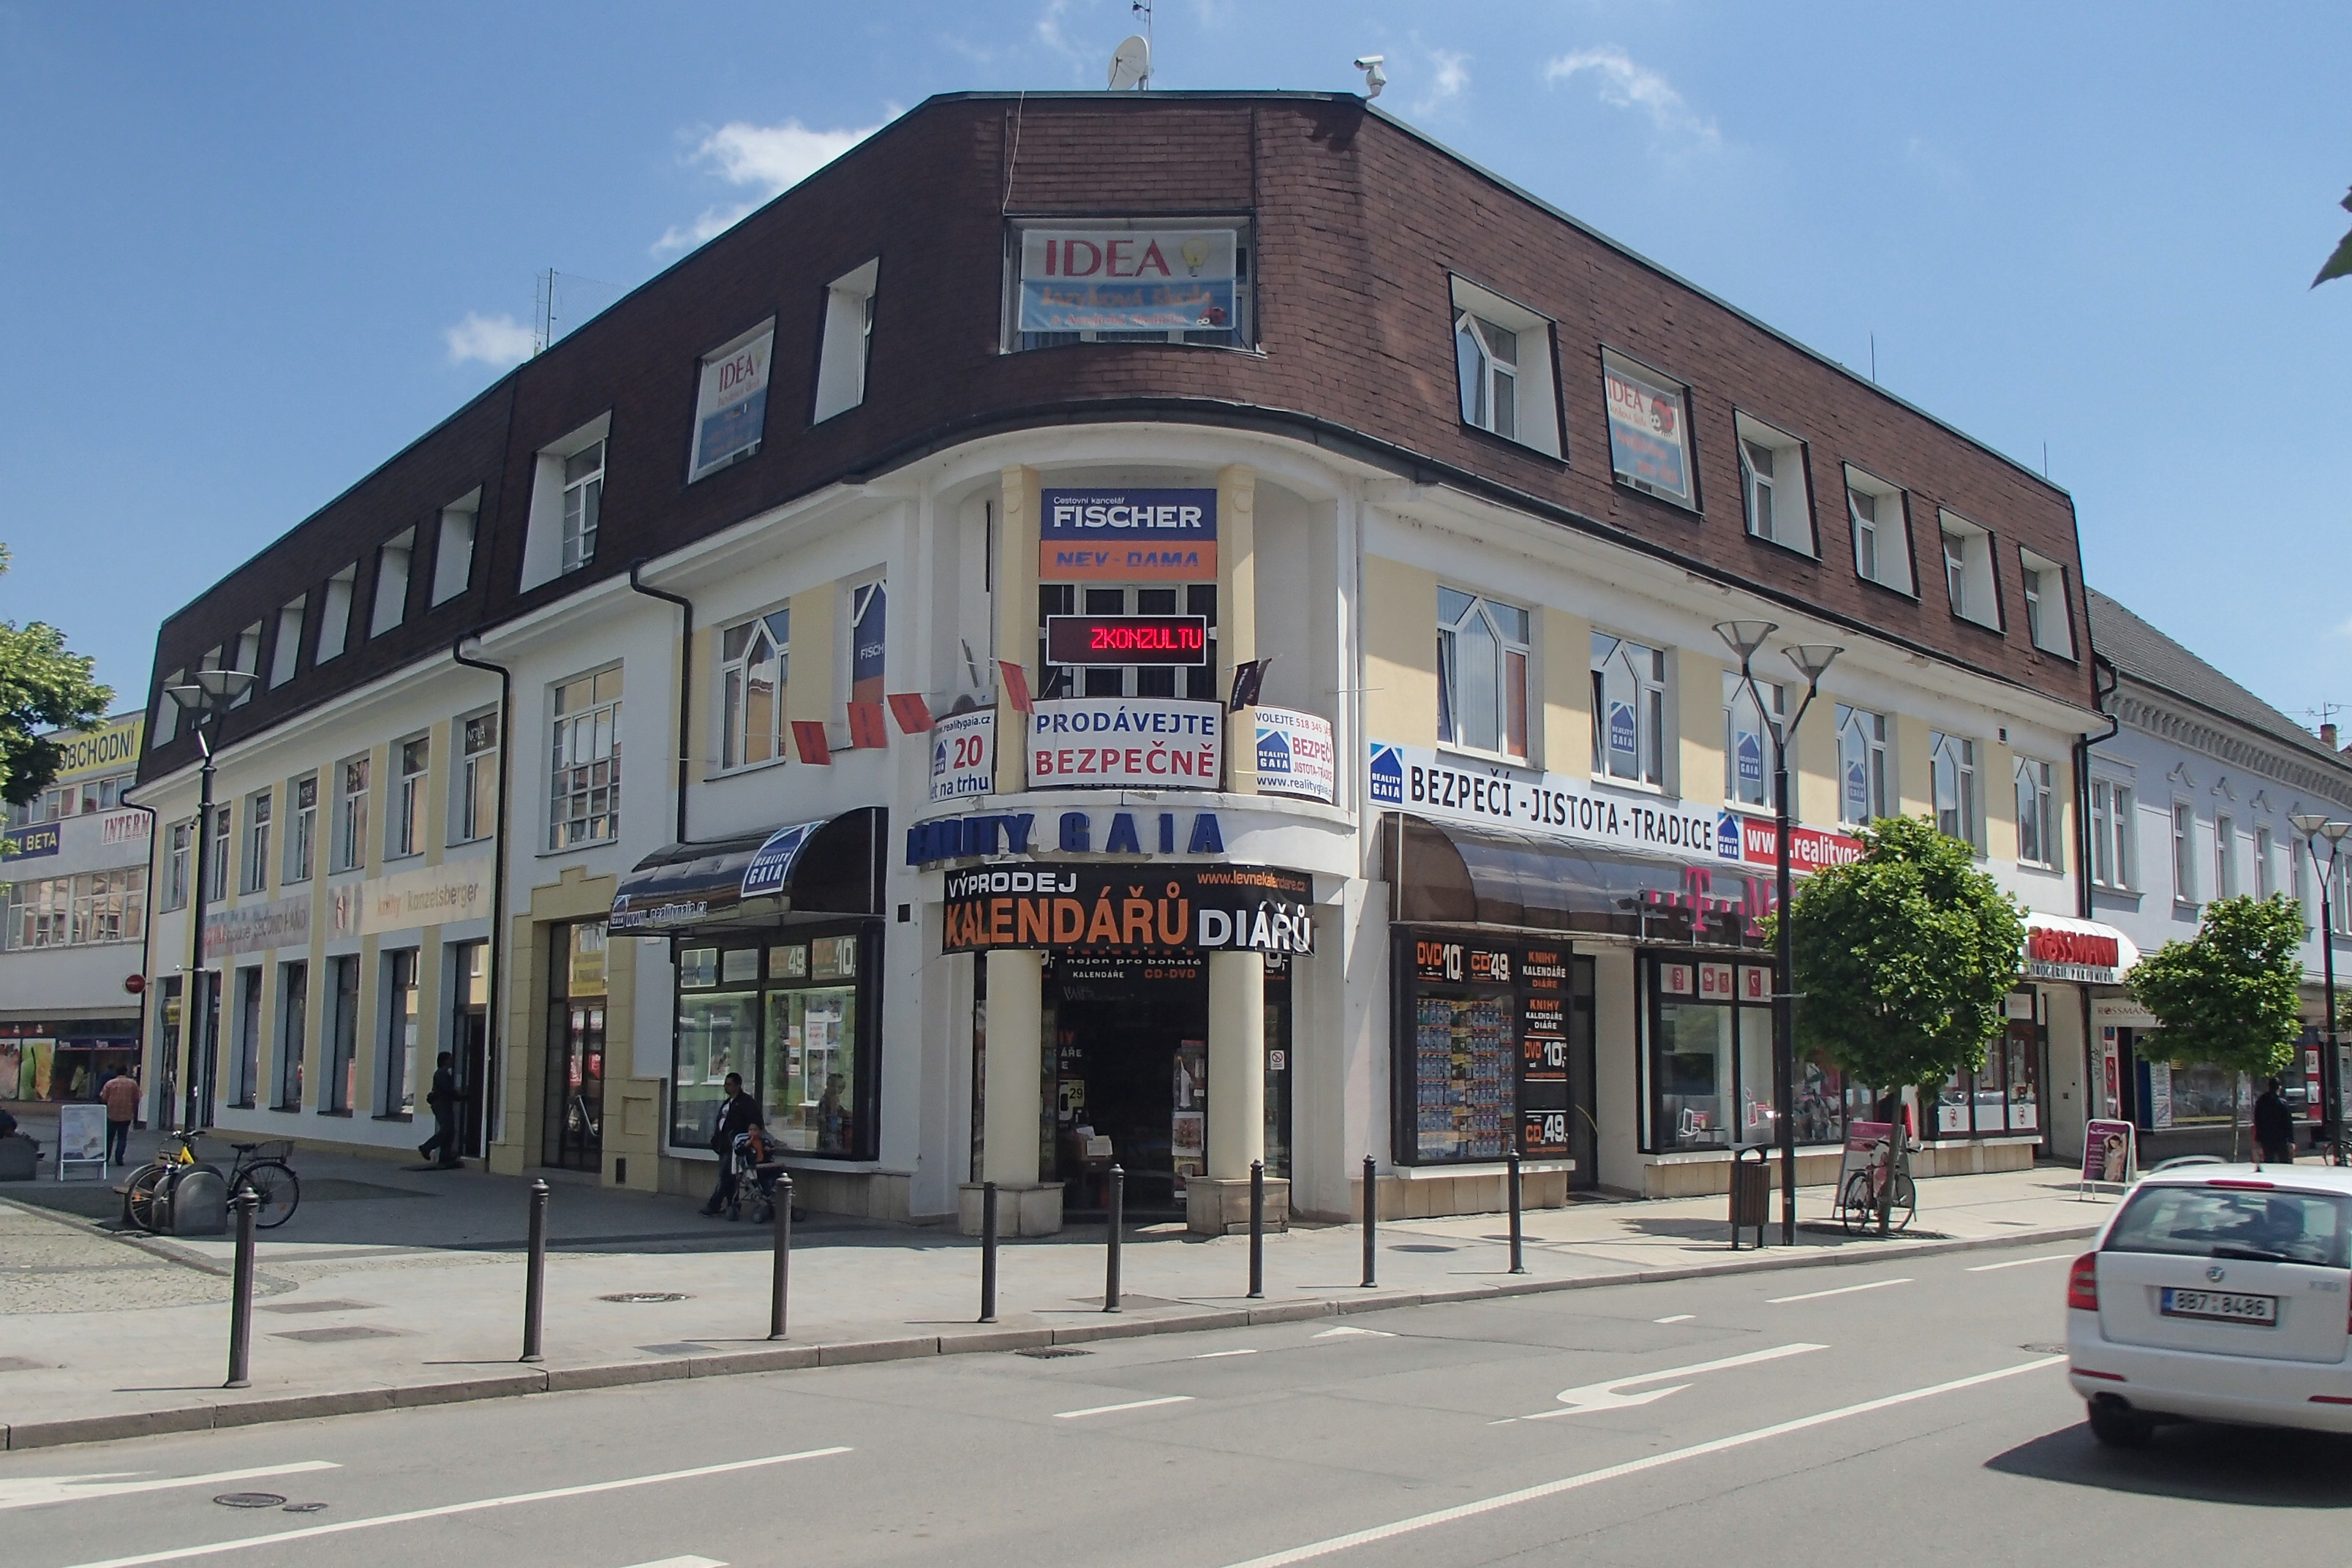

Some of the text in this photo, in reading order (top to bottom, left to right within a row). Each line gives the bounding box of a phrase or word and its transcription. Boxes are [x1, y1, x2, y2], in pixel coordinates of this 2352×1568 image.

[1046, 238, 1172, 277] IDEA
[719, 351, 755, 393] IDEA
[1606, 374, 1644, 414] IDEA
[1053, 496, 1125, 505] Cestovní kancelář
[1052, 506, 1202, 528] FISCHER
[1055, 551, 1110, 568] NEV
[1126, 551, 1199, 568] DAMA
[1090, 627, 1202, 649] ZKONZULTU
[1036, 706, 1215, 736] PRODÁVEJTE
[1255, 712, 1294, 726] VOLEJTE
[1296, 718, 1309, 729] 518
[1612, 734, 1633, 747] GAIA
[954, 735, 984, 769] 20
[1036, 741, 1215, 777] BEZPEČNĚ
[1259, 750, 1289, 759] REALITY
[1260, 758, 1289, 769] GAIA
[1741, 764, 1759, 776] GAIA
[941, 782, 954, 796] na
[957, 773, 989, 794] trhu
[1371, 773, 1401, 784] REALITY
[1373, 783, 1401, 799] GAIA
[26, 832, 58, 851] BETA
[1059, 813, 1225, 855] GAIA
[1719, 843, 1738, 856] GAIA
[748, 864, 783, 885] GAIA
[949, 870, 1306, 899] VÝPRODEJ www.levnekalendare.cz
[407, 883, 480, 912] kanzelsberger
[945, 881, 1311, 953] KALENDÁŘŮ DIÁŘŮ
[1417, 941, 1444, 966] DVD
[2028, 925, 2119, 968] ROSSMANN
[1066, 957, 1110, 967] nejen
[1116, 958, 1142, 967] pro
[1147, 955, 1202, 966] bohaté
[1472, 954, 1491, 972] CD
[1528, 951, 1558, 965] KNIHY
[1073, 968, 1196, 980] KALENDÁŘE CD-DVD
[1523, 965, 1567, 979] KALENDÁŘE
[2030, 964, 2068, 979] DROGERIE
[1532, 979, 1558, 990] DIÁŘE
[1529, 999, 1560, 1011] KNIHY
[1534, 1021, 1557, 1030] DIÁŘE
[1525, 1041, 1542, 1059] DVD
[1069, 1088, 1083, 1100] 29
[1526, 1125, 1542, 1142] CD
